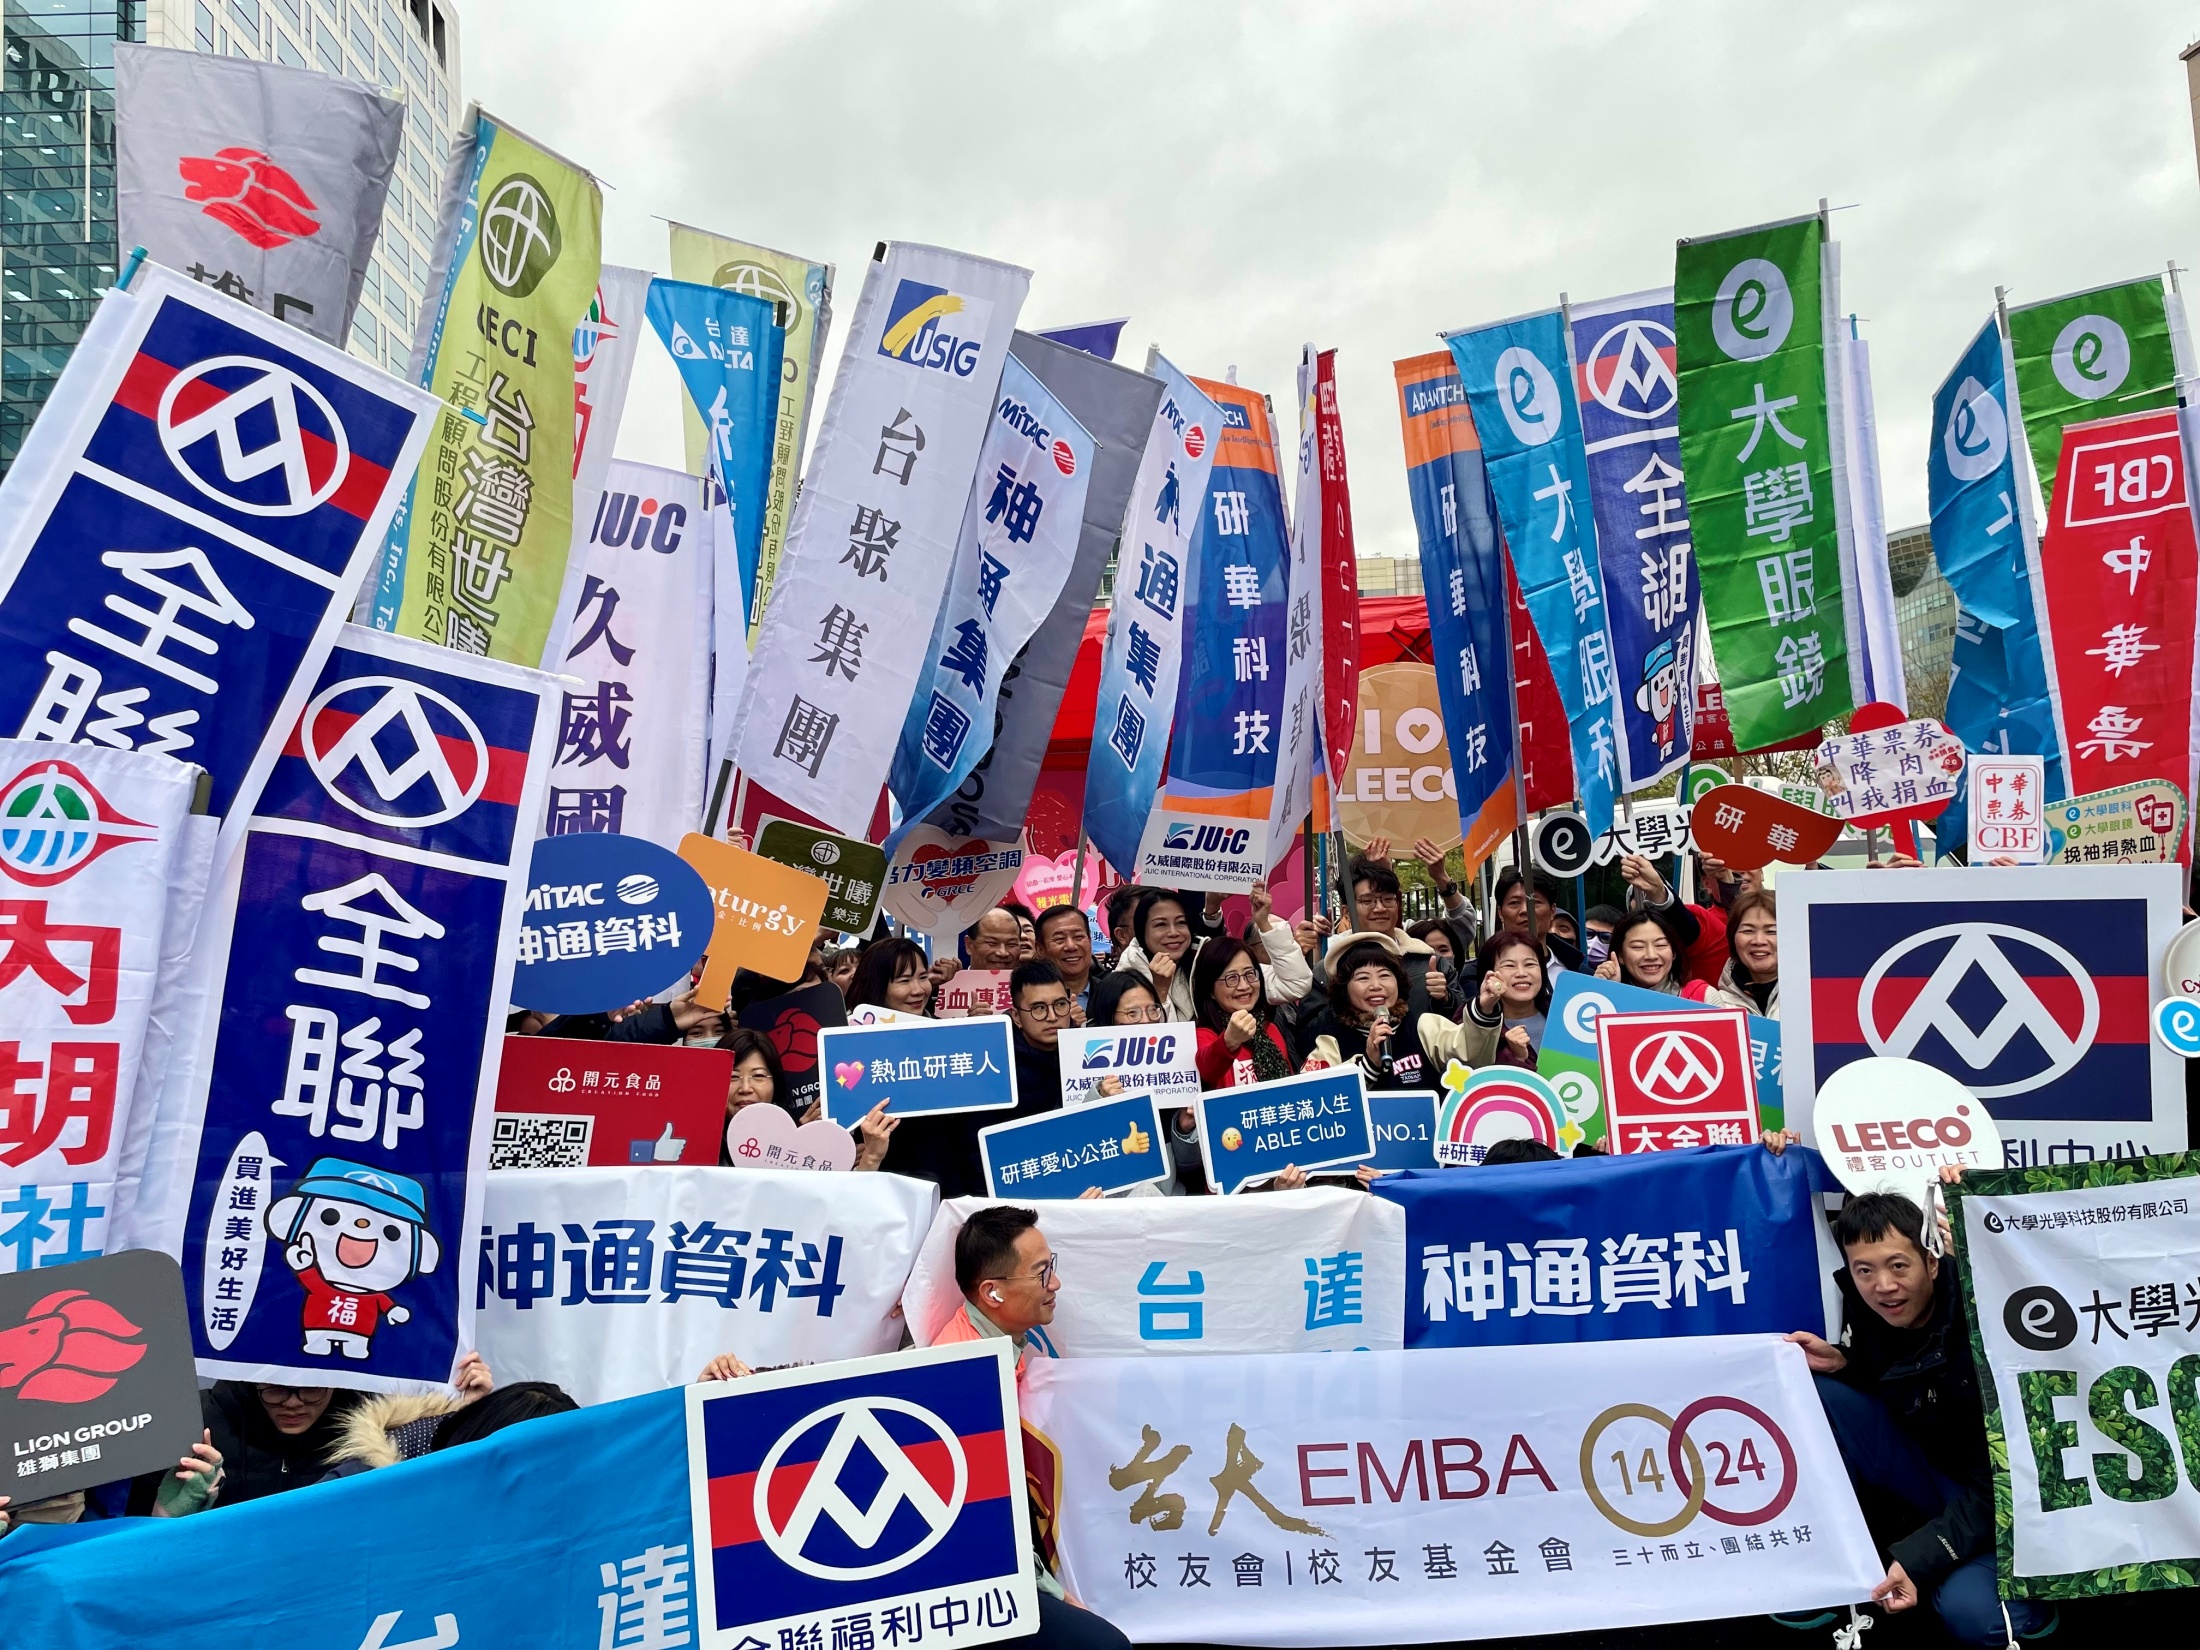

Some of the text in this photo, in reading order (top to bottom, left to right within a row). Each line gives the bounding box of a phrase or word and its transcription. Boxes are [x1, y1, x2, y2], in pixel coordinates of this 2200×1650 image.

[911, 326, 981, 378] USIG
[999, 396, 1051, 452] MiTAC
[421, 350, 486, 645] 工程顧問股份有限公
[1730, 383, 1825, 712] 大學眼鏡
[772, 407, 926, 778] 台聚集團
[1213, 490, 1271, 756] 研華科技
[1440, 484, 1488, 775] 研華科技
[1820, 722, 1943, 767] 中華票券
[1850, 753, 1924, 786] 降肉
[1985, 773, 2029, 797] 中華
[1829, 776, 1956, 817] 叫我捐血
[1986, 799, 2031, 822] 票券
[2083, 799, 2132, 818] 大學眼科
[1713, 801, 1800, 853] 研華
[1978, 826, 2038, 849] CBF
[2085, 818, 2133, 836] 大學眼鏡
[1145, 853, 1263, 877] 久威國際股份有限公司
[2064, 834, 2157, 864] 挽袖捐熱血
[935, 881, 977, 897] GREE
[1160, 868, 1213, 880] INTERNATIONAL
[271, 872, 446, 1152] 全聯
[582, 1070, 661, 1090] 開元食品
[870, 1049, 1001, 1085] 熱血研華人
[1066, 1070, 1197, 1092] 久威股份有限公司
[1392, 1053, 1423, 1077] NTU
[1241, 1093, 1352, 1131] 研華美滿人生
[1254, 1121, 1347, 1153] ABLE Club
[1371, 1122, 1429, 1143] NO.1
[1832, 1116, 1972, 1154] LEECO
[1000, 1137, 1120, 1186] 研華愛心公益
[2003, 1198, 2189, 1231] 大學光學科技股份有限公司
[210, 1155, 264, 1333] 買進美好生活
[476, 1219, 846, 1318] 神通資科
[1421, 1229, 1750, 1322] 神通資科
[327, 1294, 360, 1328] 福
[1136, 1250, 1364, 1341] 台達
[14, 1413, 153, 1457] LION GROUP
[16, 1442, 102, 1478] 雄獅集團
[1610, 1437, 1766, 1496] 14 24
[1108, 1422, 1559, 1541] 台大 EMBA
[1612, 1524, 1813, 1567] 三十而立、團結共好
